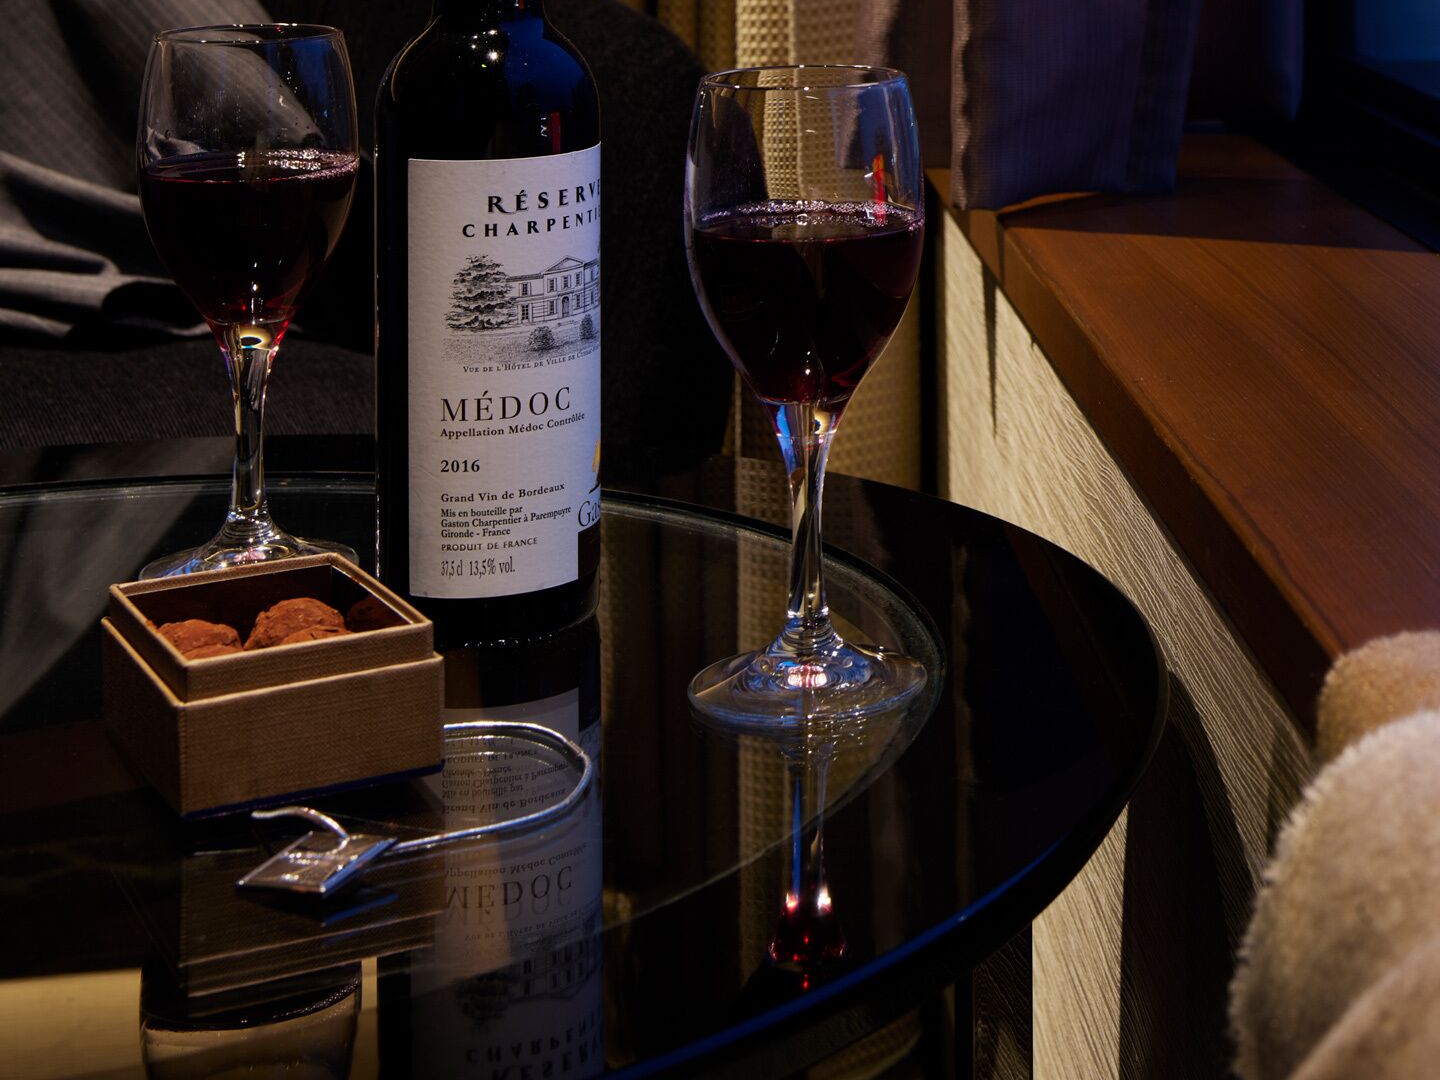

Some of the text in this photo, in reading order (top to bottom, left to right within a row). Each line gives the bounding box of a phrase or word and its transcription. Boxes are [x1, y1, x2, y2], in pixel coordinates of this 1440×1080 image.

[440, 386, 571, 422] MÉDOC
[440, 411, 586, 440] Appellation Médoc Contrôlée
[440, 459, 481, 473] 2016
[441, 483, 566, 503] Grand Vin de Bordeaux
[441, 506, 524, 519] Mis en bouteille par
[441, 506, 572, 529] Gaston Charpentier à Parempuyre
[441, 529, 475, 539] Gironde
[482, 527, 511, 538] France
[441, 537, 539, 552] PRODUIT DE FRANCE
[456, 559, 464, 577] cl
[469, 557, 497, 579] 13,5%
[499, 555, 516, 574] vol.
